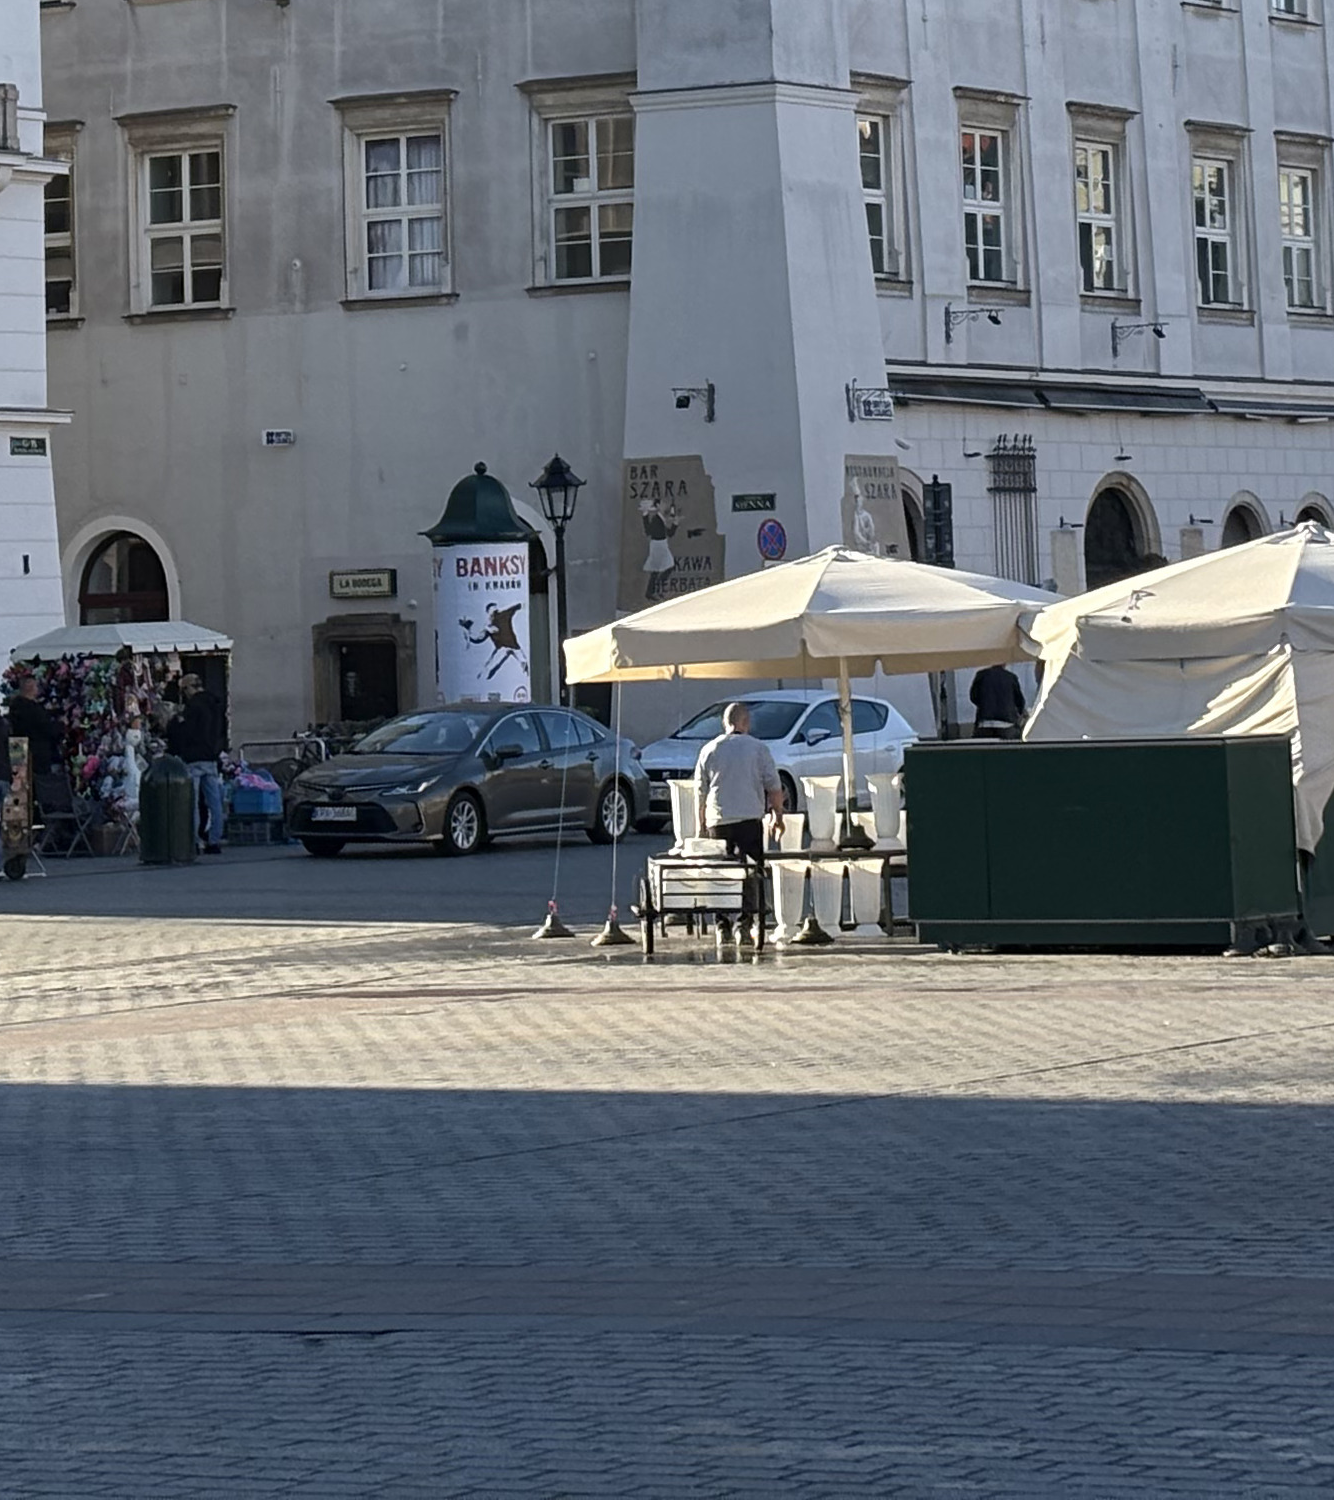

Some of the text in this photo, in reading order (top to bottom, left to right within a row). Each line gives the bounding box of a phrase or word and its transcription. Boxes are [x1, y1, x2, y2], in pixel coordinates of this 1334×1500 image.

[630, 465, 658, 480] BAR
[629, 479, 688, 499] SZARA
[864, 483, 898, 500] SZARA
[456, 555, 526, 577] BANKSY
[673, 555, 712, 572] KAWA
[339, 578, 350, 589] LA
